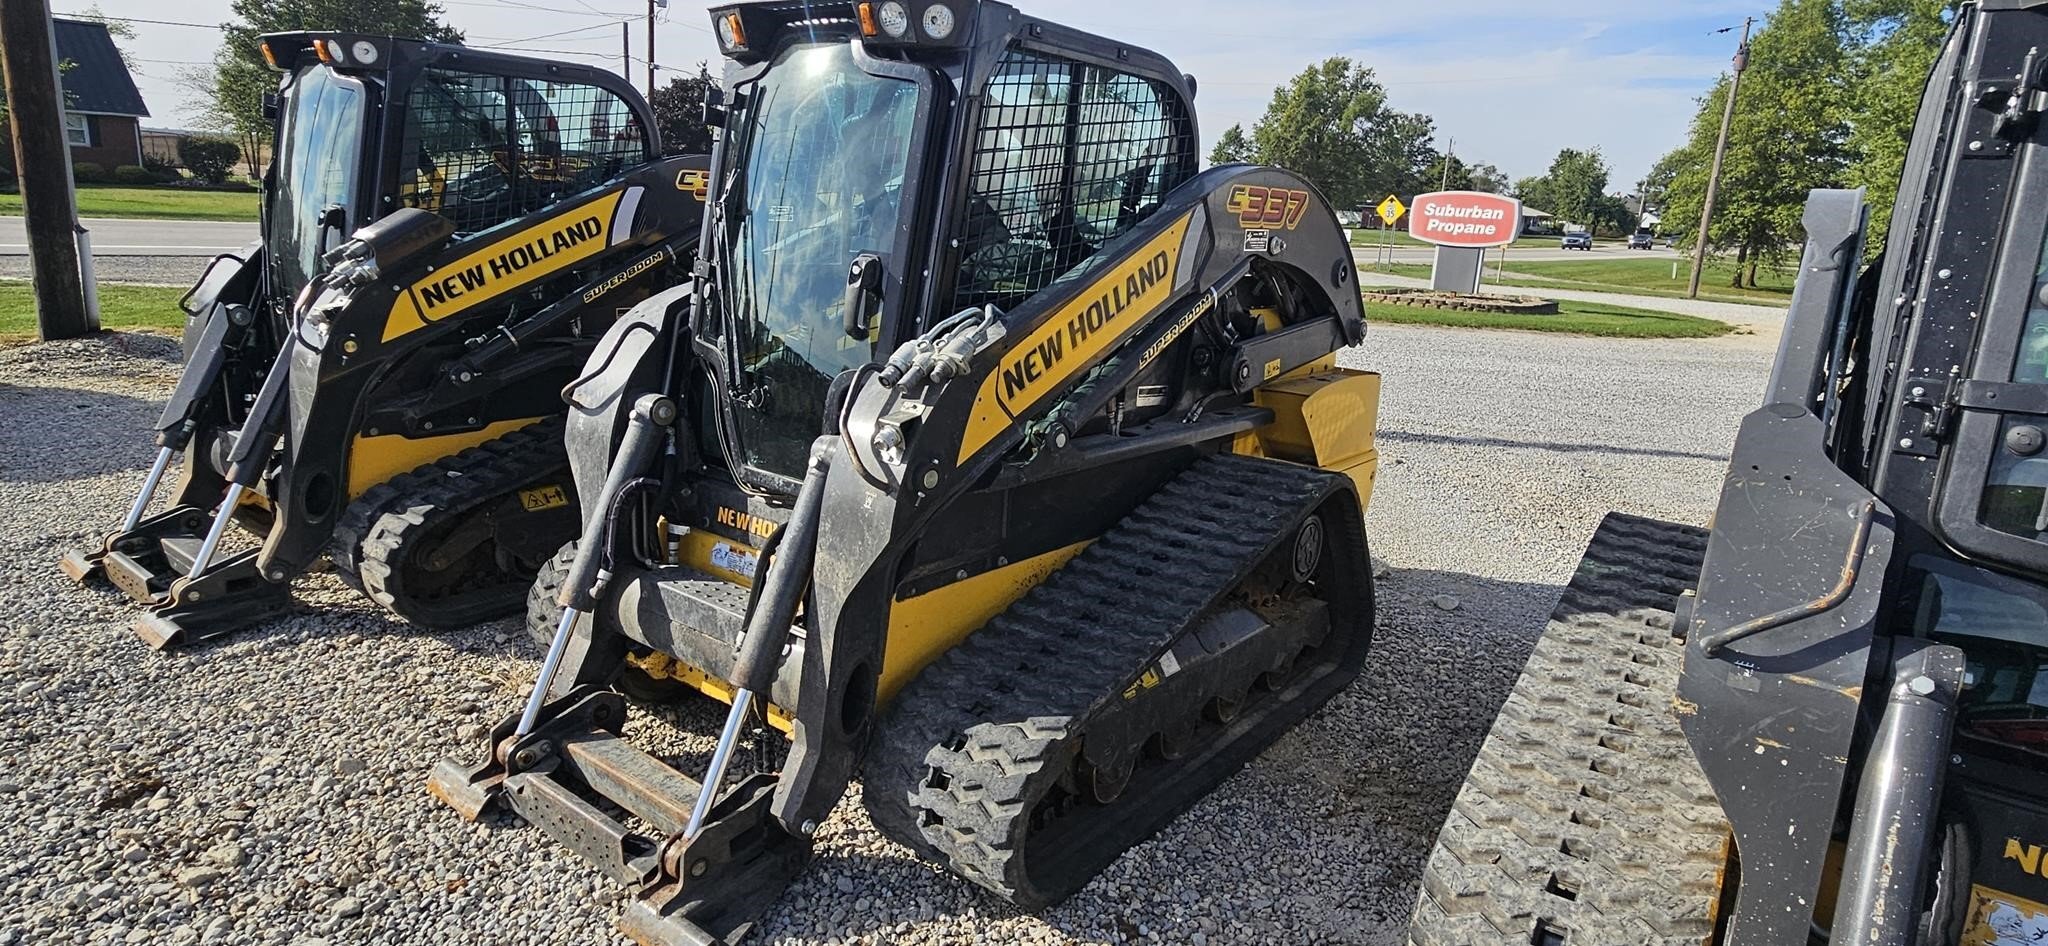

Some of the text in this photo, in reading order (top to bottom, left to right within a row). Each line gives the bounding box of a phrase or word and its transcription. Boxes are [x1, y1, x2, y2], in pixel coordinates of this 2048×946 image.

[1227, 185, 1309, 230] C337
[1424, 203, 1504, 219] Suburban
[1426, 219, 1496, 235] Propane
[420, 215, 602, 309] NEW HOLLAND
[584, 251, 663, 303] SUPER BOOM
[1002, 250, 1168, 400] NEW HOLLAND
[1139, 293, 1211, 369] SUPER BOOM
[717, 506, 750, 530] NEW
